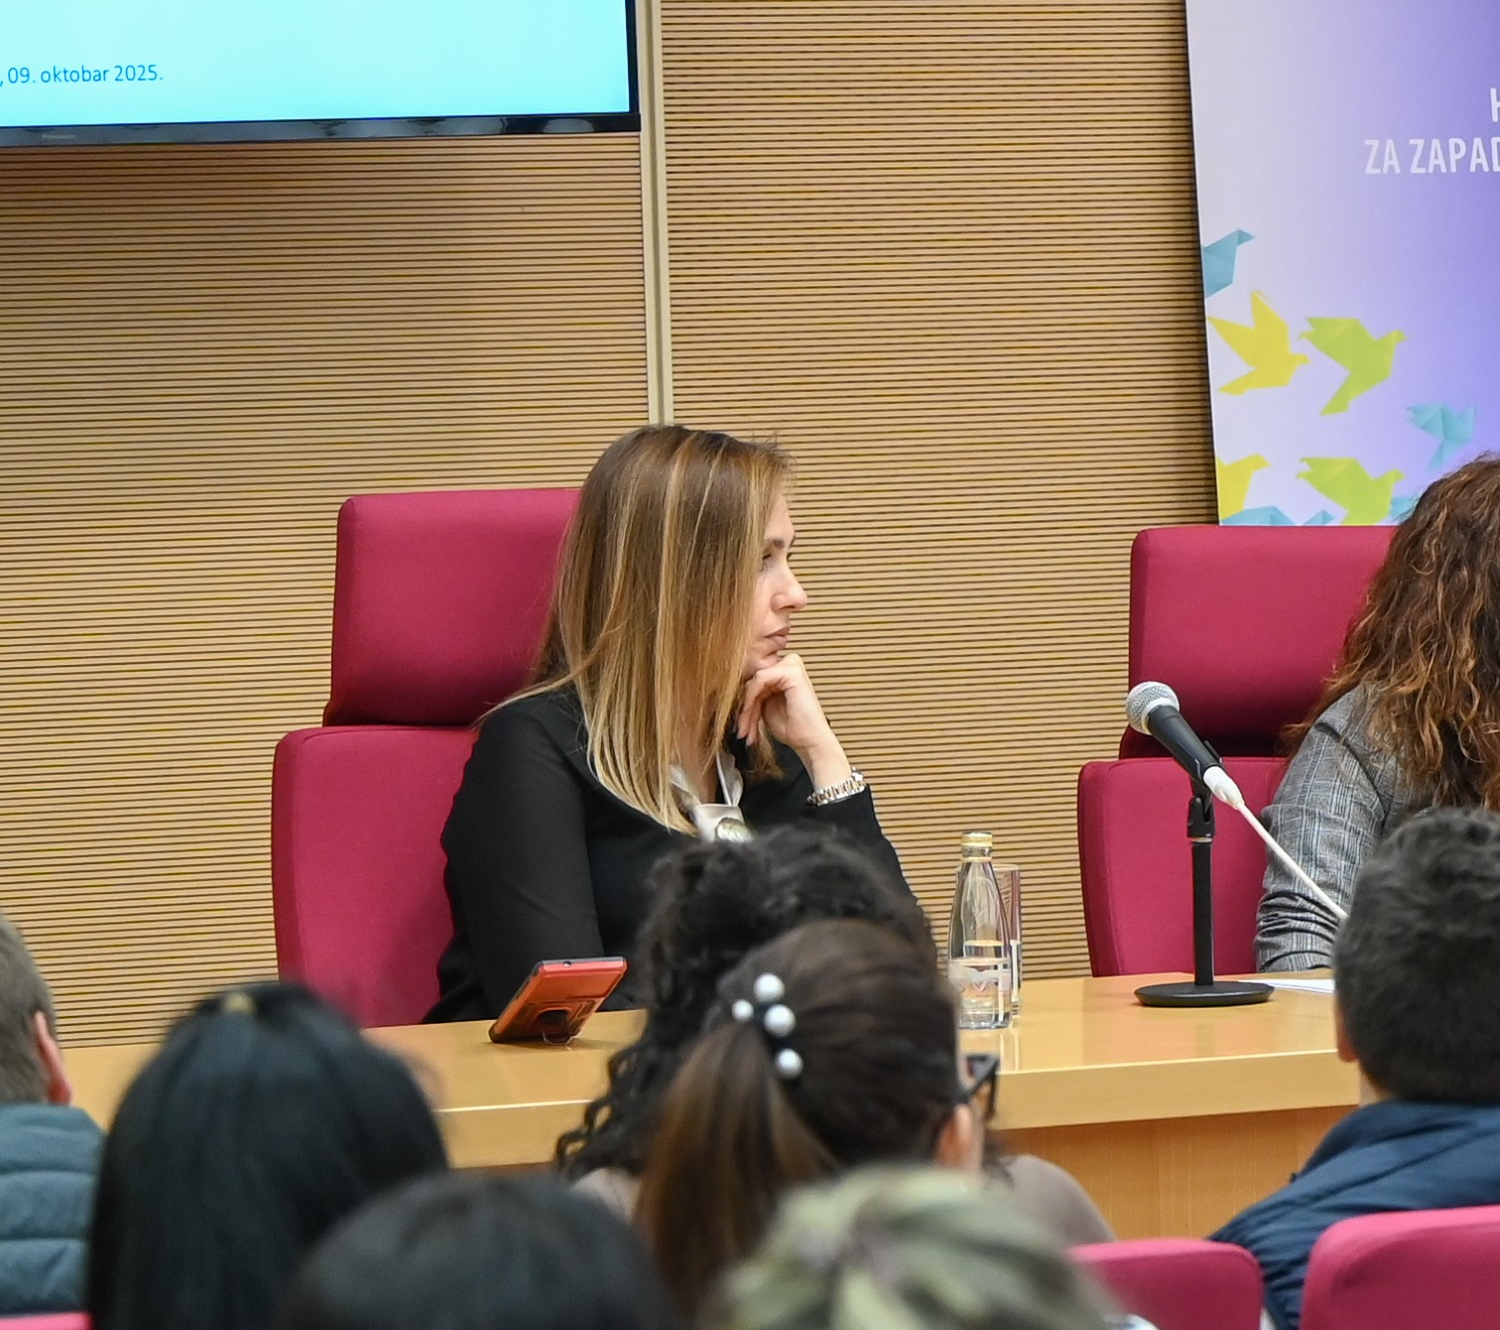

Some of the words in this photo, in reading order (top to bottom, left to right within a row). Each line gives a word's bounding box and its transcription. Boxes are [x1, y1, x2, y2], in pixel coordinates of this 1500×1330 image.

[8, 67, 35, 83] 09.
[41, 65, 109, 83] oktobar
[114, 64, 163, 81] 2025.
[1364, 139, 1400, 174] ZA
